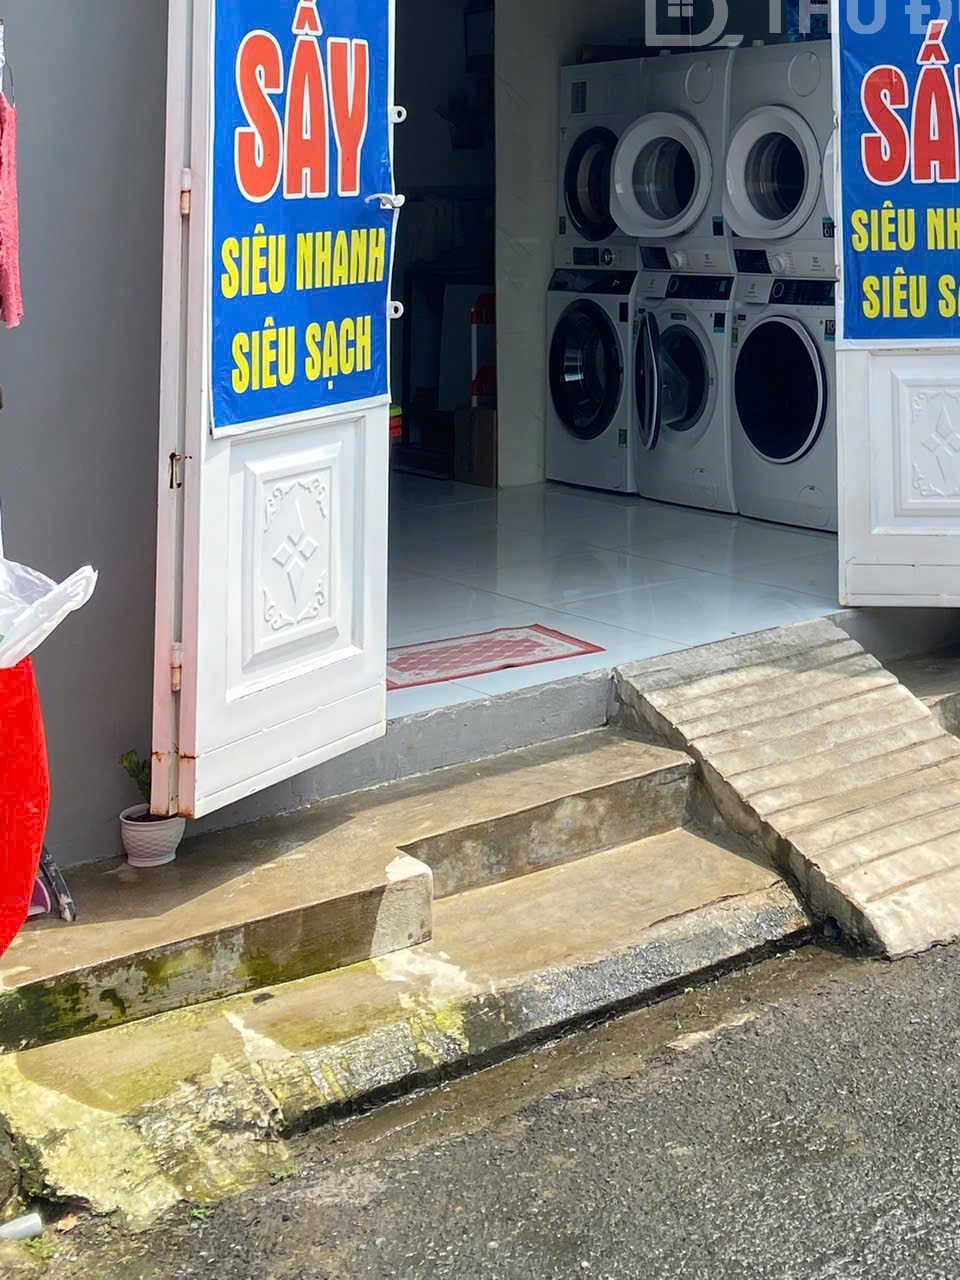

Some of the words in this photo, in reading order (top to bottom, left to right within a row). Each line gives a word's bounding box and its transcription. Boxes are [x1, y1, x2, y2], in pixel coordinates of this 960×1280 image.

[851, 200, 915, 252] SIÊU
[221, 223, 285, 300] SIÊU
[296, 228, 386, 291] NHANH
[862, 266, 928, 318] SIÊU
[231, 316, 294, 395] SIÊU
[304, 314, 371, 390] SẠCH
